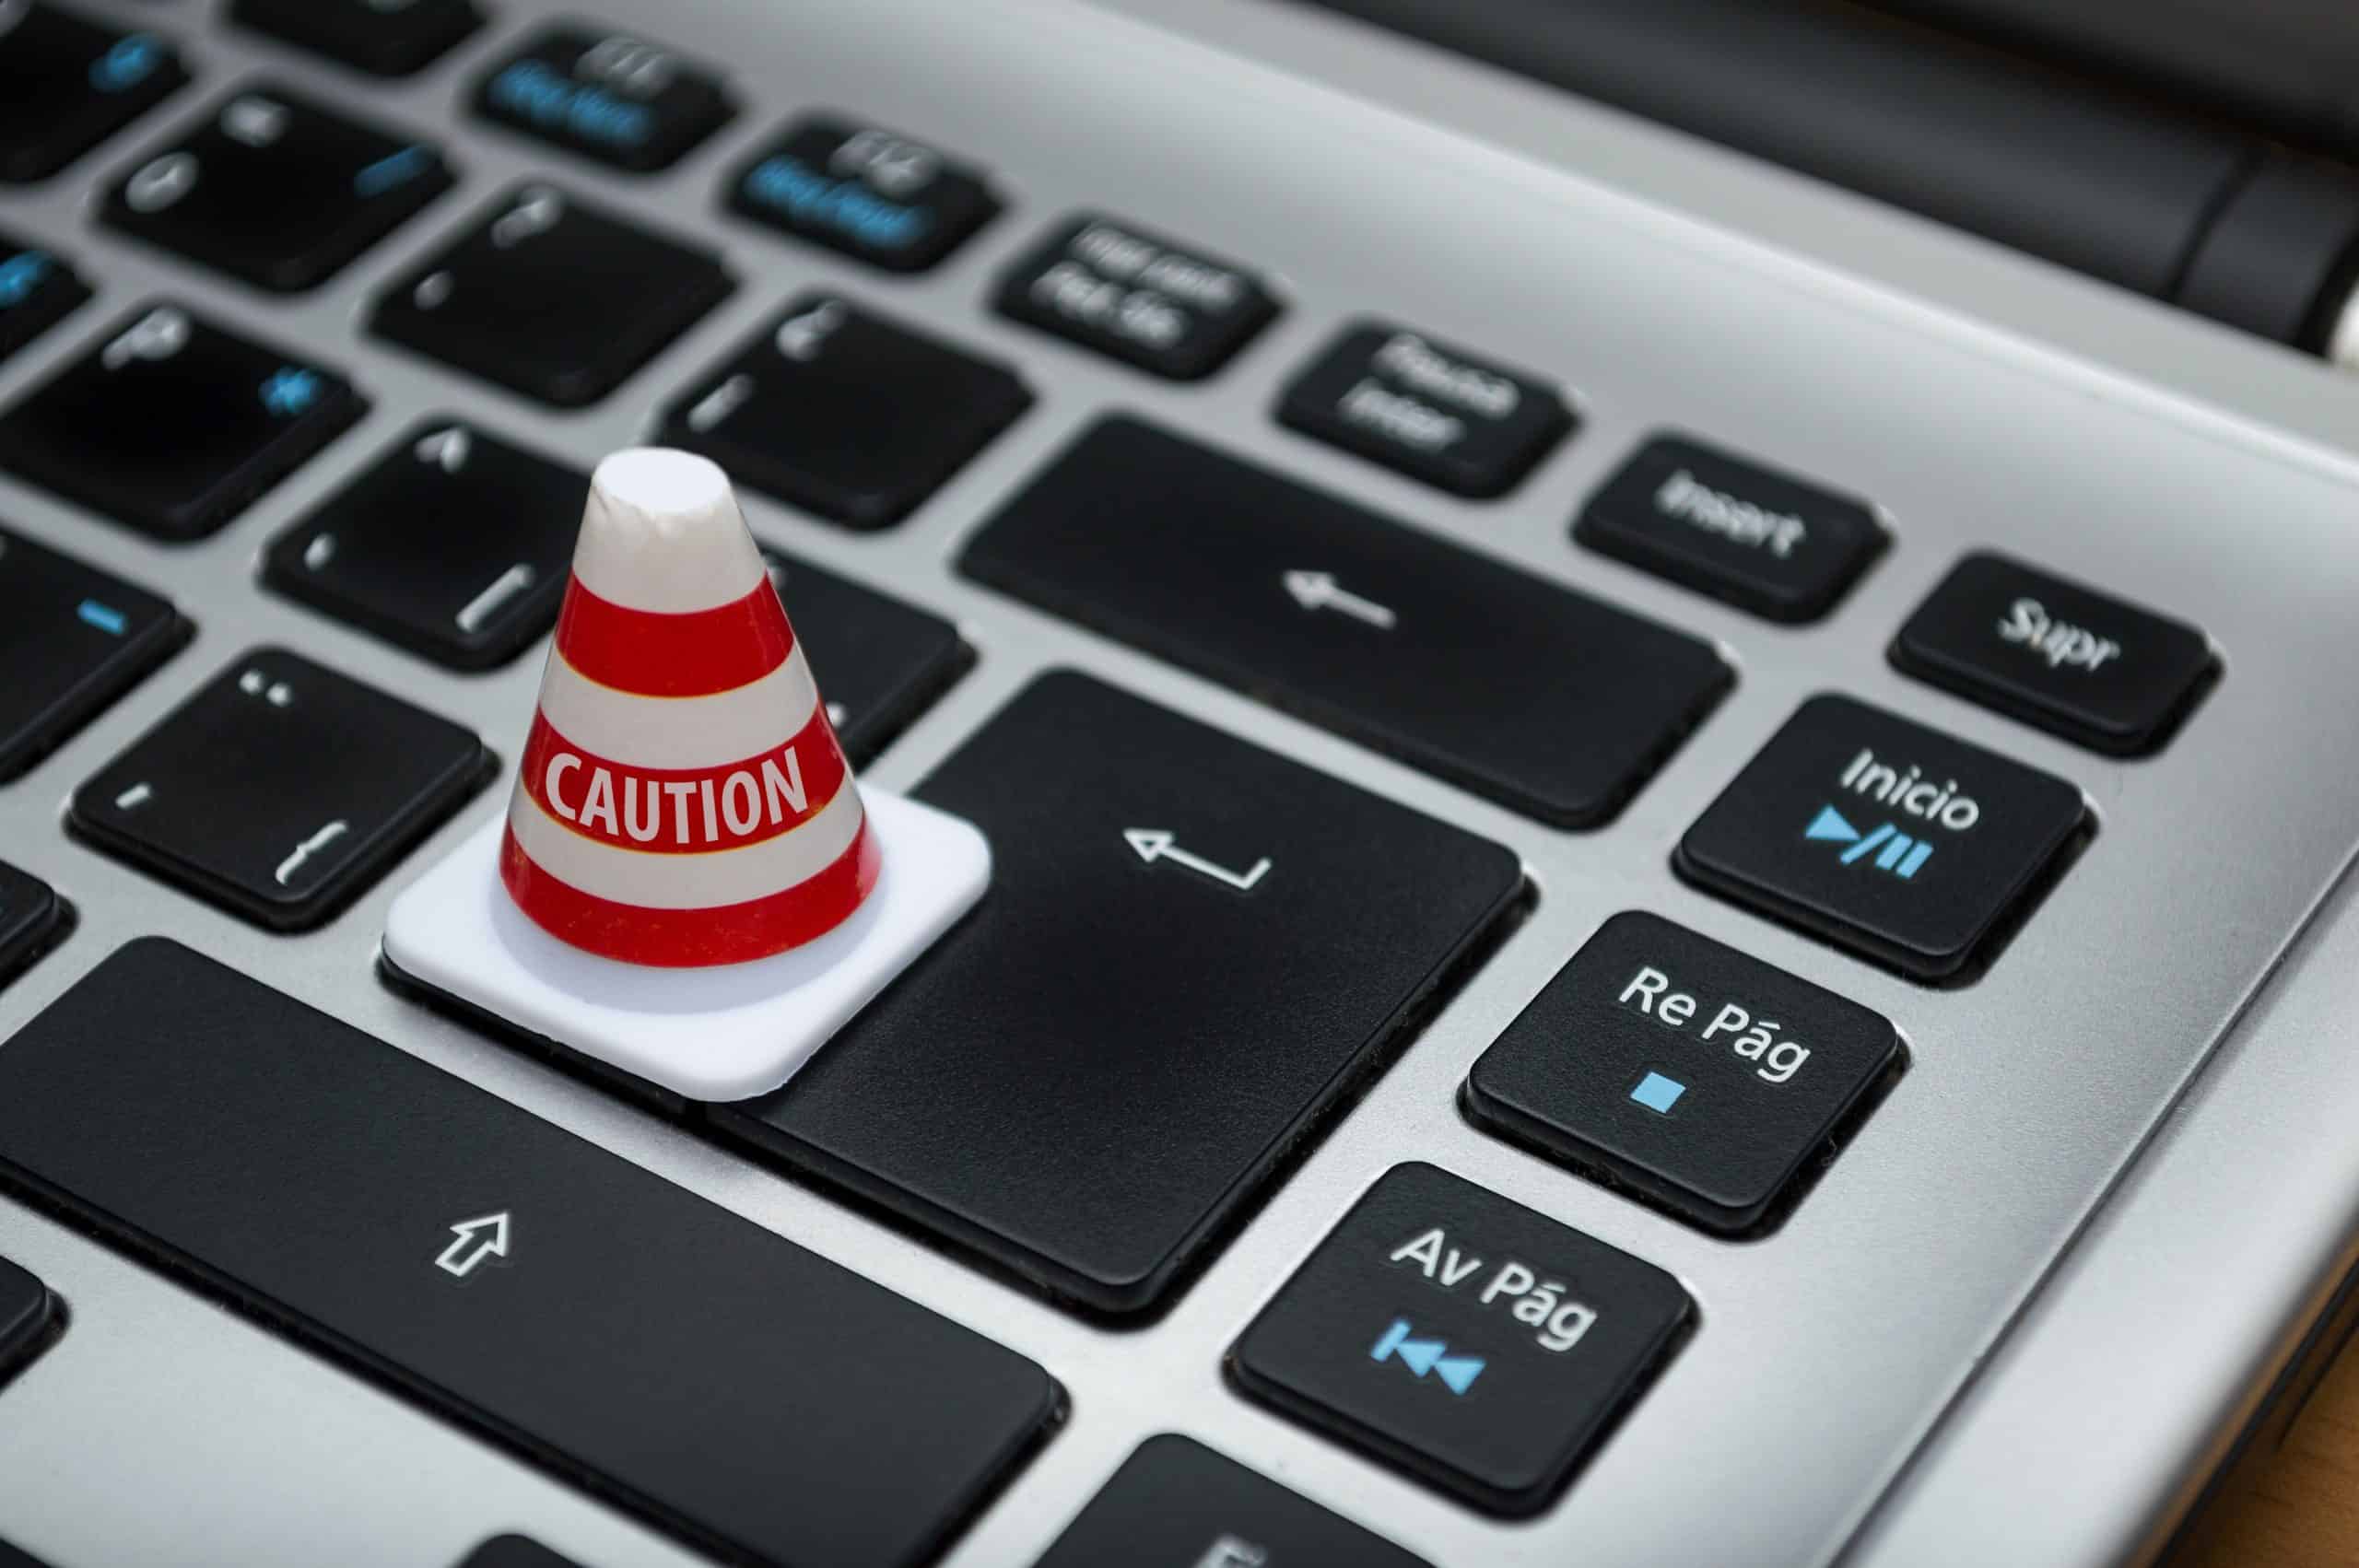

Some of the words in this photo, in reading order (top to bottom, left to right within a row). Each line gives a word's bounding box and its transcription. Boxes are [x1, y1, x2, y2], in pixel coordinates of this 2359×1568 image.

[1655, 469, 1806, 557] Insert
[1997, 597, 2121, 673] Supr
[546, 745, 808, 844] CAUTION
[1841, 747, 1980, 831] Inicio
[1619, 966, 1696, 1026] Re
[1701, 1002, 1811, 1082] Pág
[1390, 1227, 1483, 1287] Av
[1480, 1261, 1598, 1352] Pág
